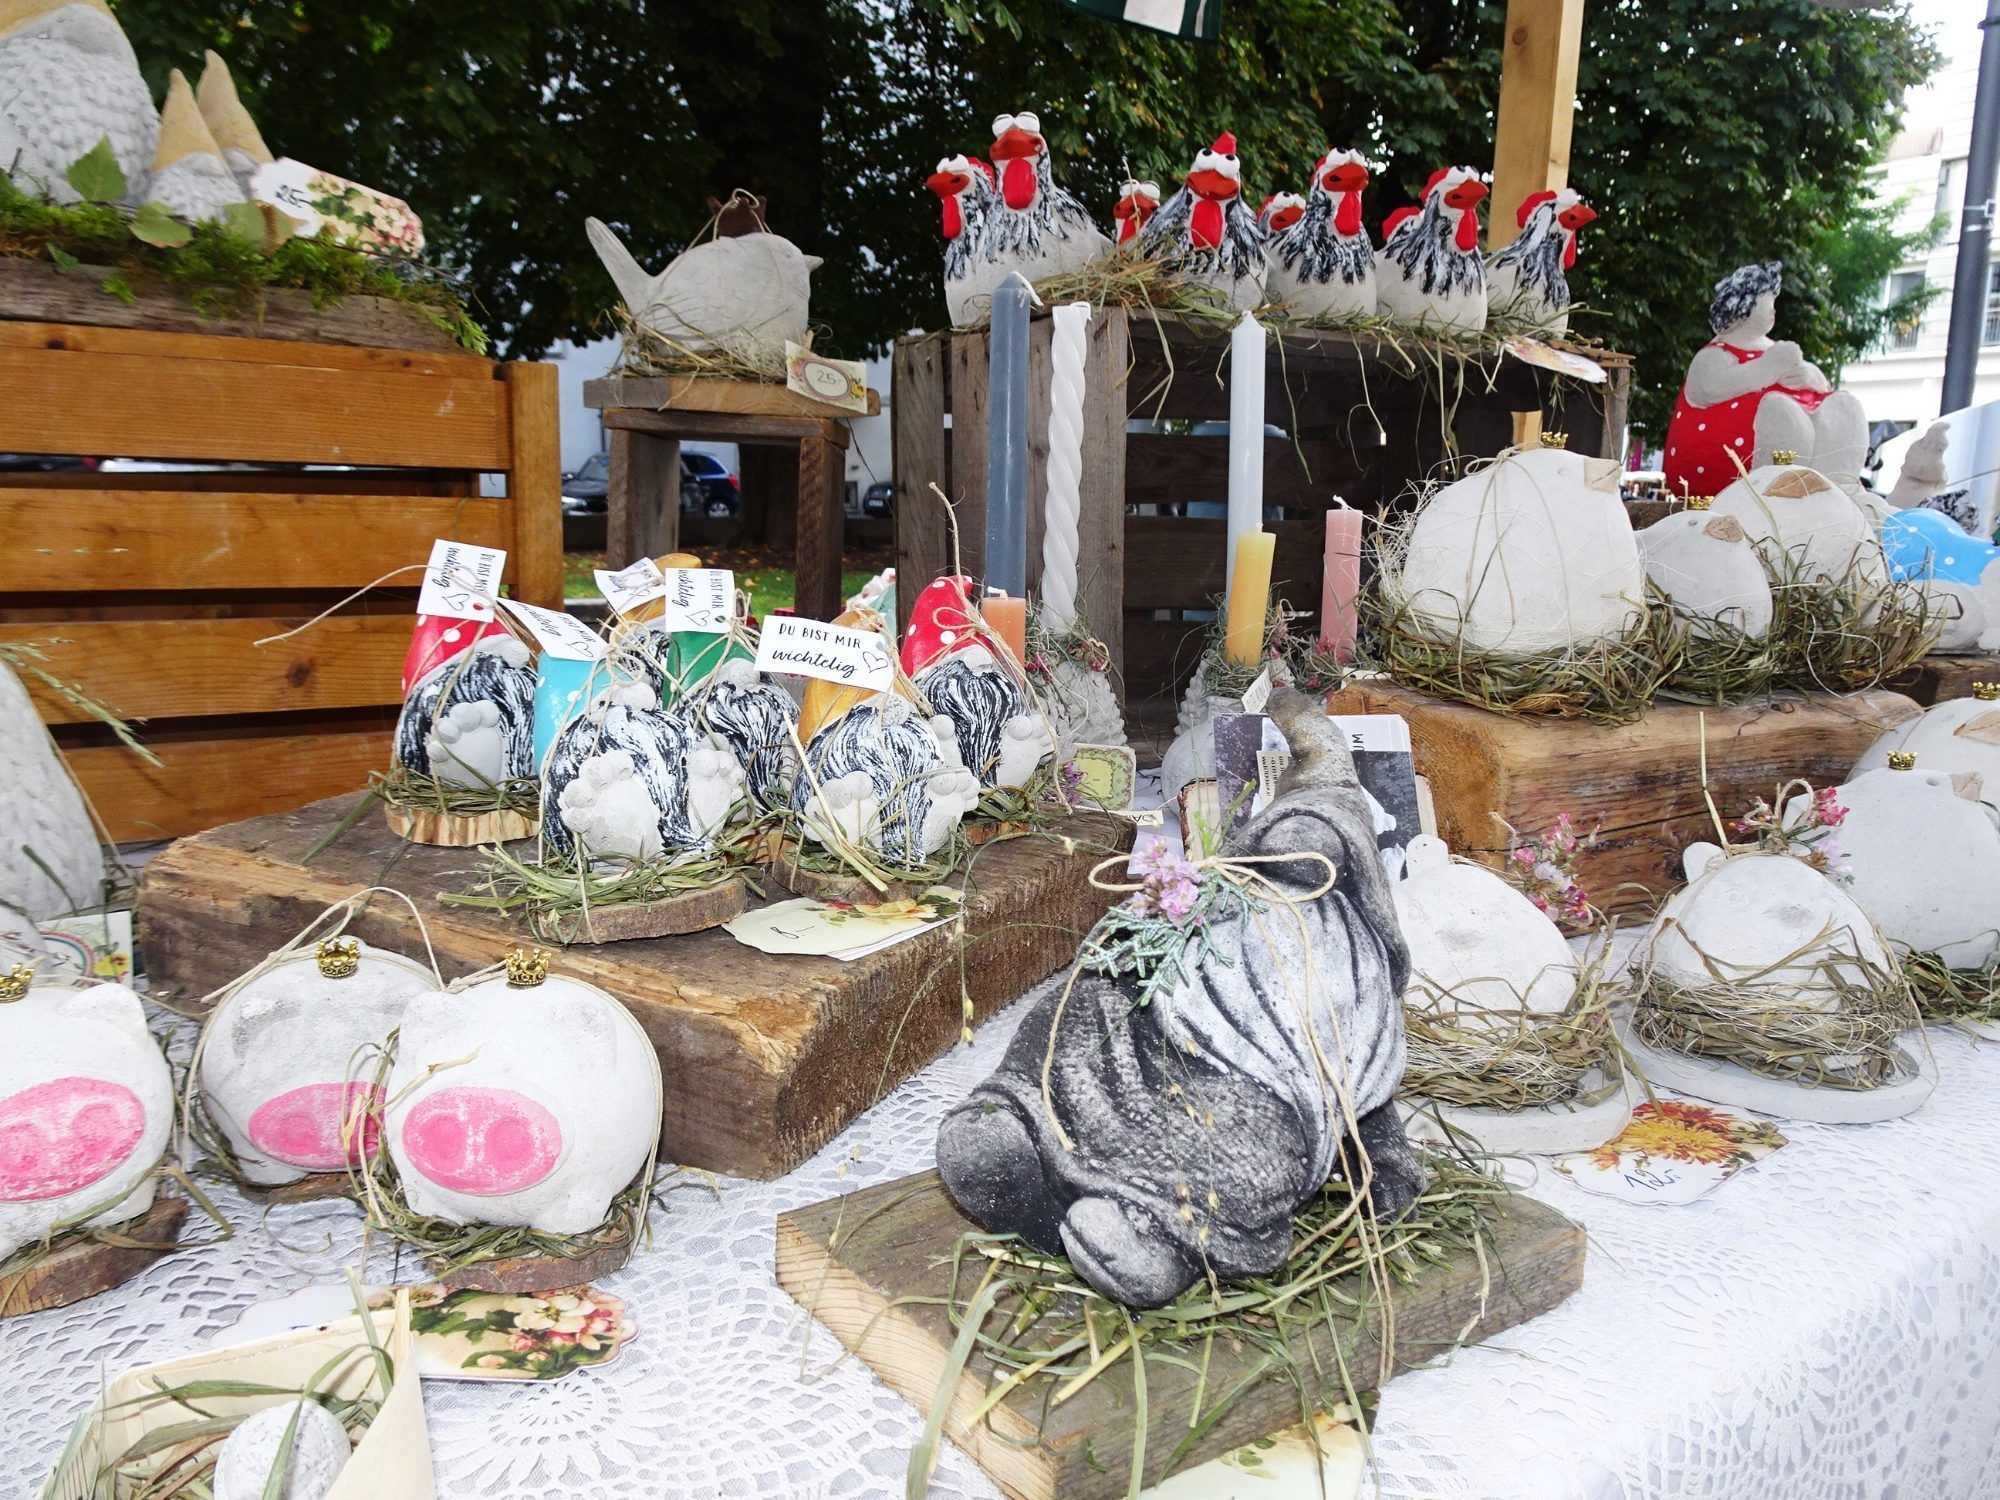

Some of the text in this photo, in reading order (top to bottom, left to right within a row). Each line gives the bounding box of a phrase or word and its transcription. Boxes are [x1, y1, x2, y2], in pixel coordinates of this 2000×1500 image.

[711, 594, 724, 609] MIR
[779, 623, 861, 649] DU BIST MIR
[772, 649, 858, 679] wichtelig
